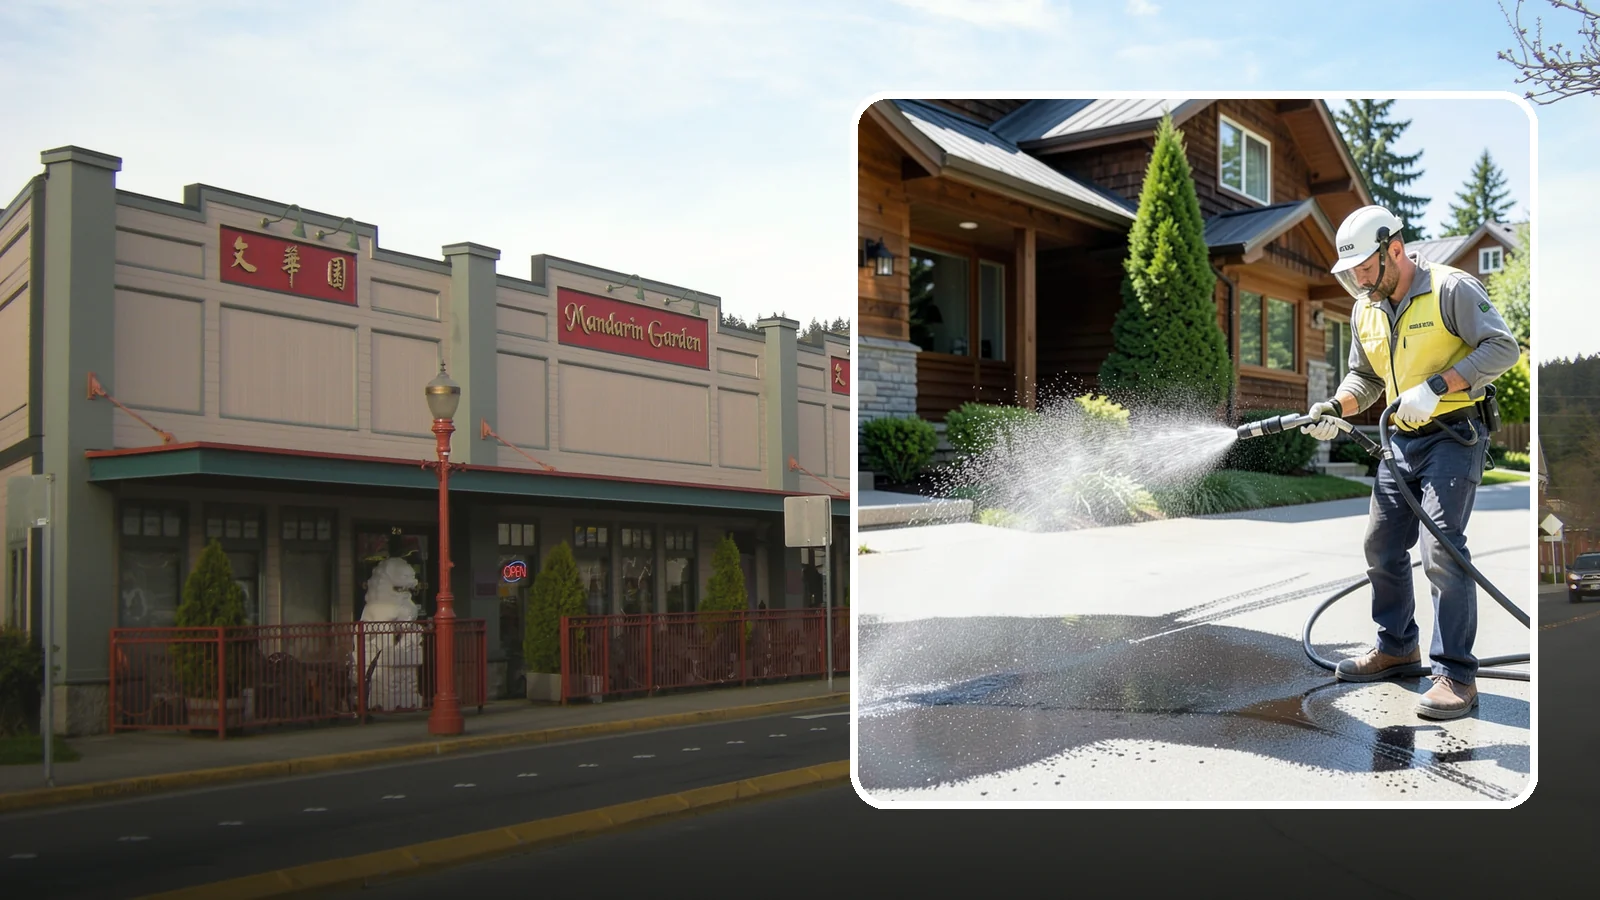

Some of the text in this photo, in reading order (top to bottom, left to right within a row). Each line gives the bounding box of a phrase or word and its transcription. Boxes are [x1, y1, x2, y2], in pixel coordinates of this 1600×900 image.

[231, 235, 346, 291] 文華園
[564, 302, 702, 352] Mandarin Garden
[503, 565, 527, 578] OPEN
